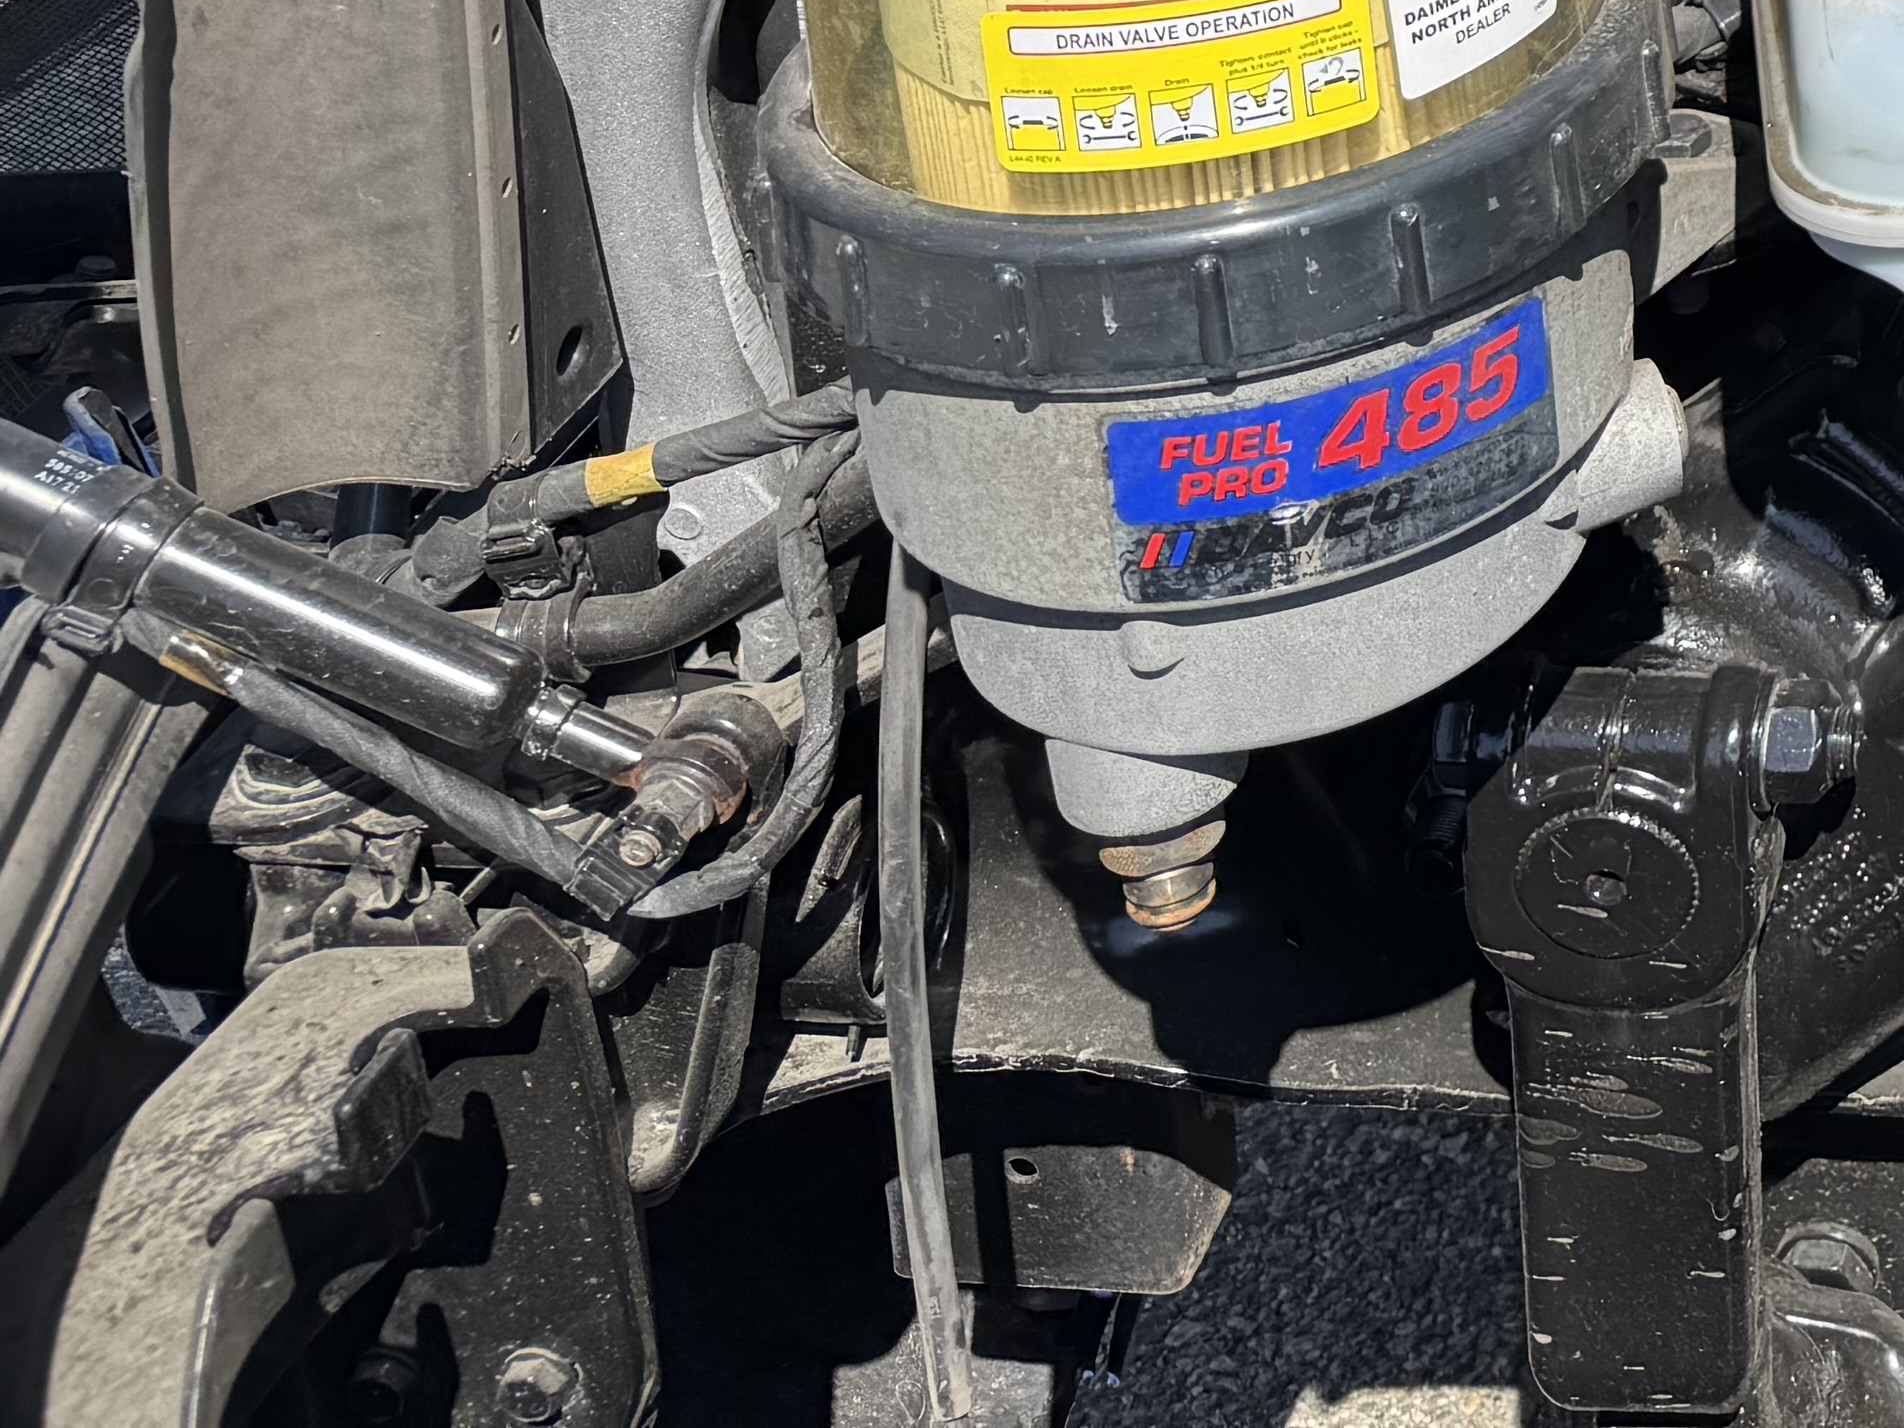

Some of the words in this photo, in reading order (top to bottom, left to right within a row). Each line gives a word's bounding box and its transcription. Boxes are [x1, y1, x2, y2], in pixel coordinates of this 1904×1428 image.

[1056, 33, 1114, 50] DRAIN
[1119, 24, 1179, 45] VALVE
[1185, 3, 1295, 38] OPERATION
[1411, 4, 1471, 45] NORTH
[1455, 3, 1511, 45] DEALER
[1257, 47, 1292, 61] contact
[1004, 87, 1033, 95] Loosen
[1036, 88, 1054, 97] cap
[1074, 86, 1105, 94] Loosen
[1108, 83, 1133, 92] drain
[1164, 77, 1190, 87] Drain
[1318, 325, 1520, 471] 485
[1160, 419, 1293, 470] FUEL
[1178, 457, 1289, 507] PRO
